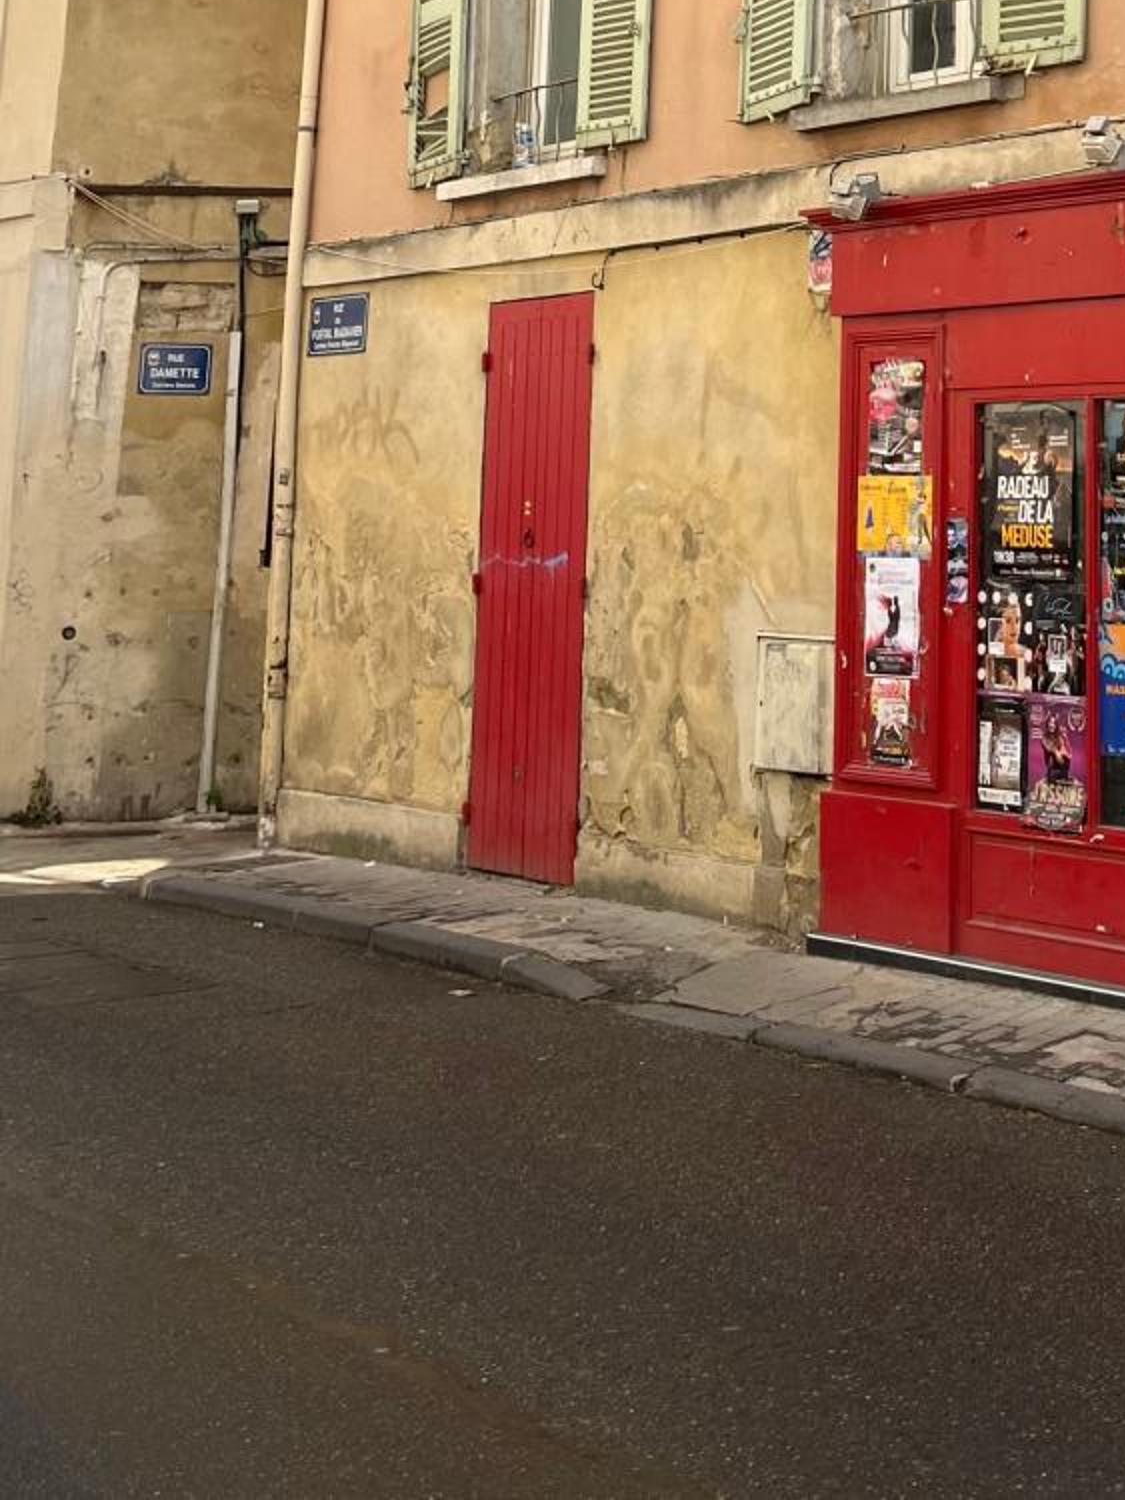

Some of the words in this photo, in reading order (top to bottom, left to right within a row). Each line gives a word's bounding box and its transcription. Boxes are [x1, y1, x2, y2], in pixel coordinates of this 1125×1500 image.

[167, 353, 185, 363] RUE
[149, 367, 200, 379] DAMETTE
[997, 476, 1049, 499] RADEAU
[1018, 500, 1035, 523] DE
[1037, 501, 1054, 524] LA
